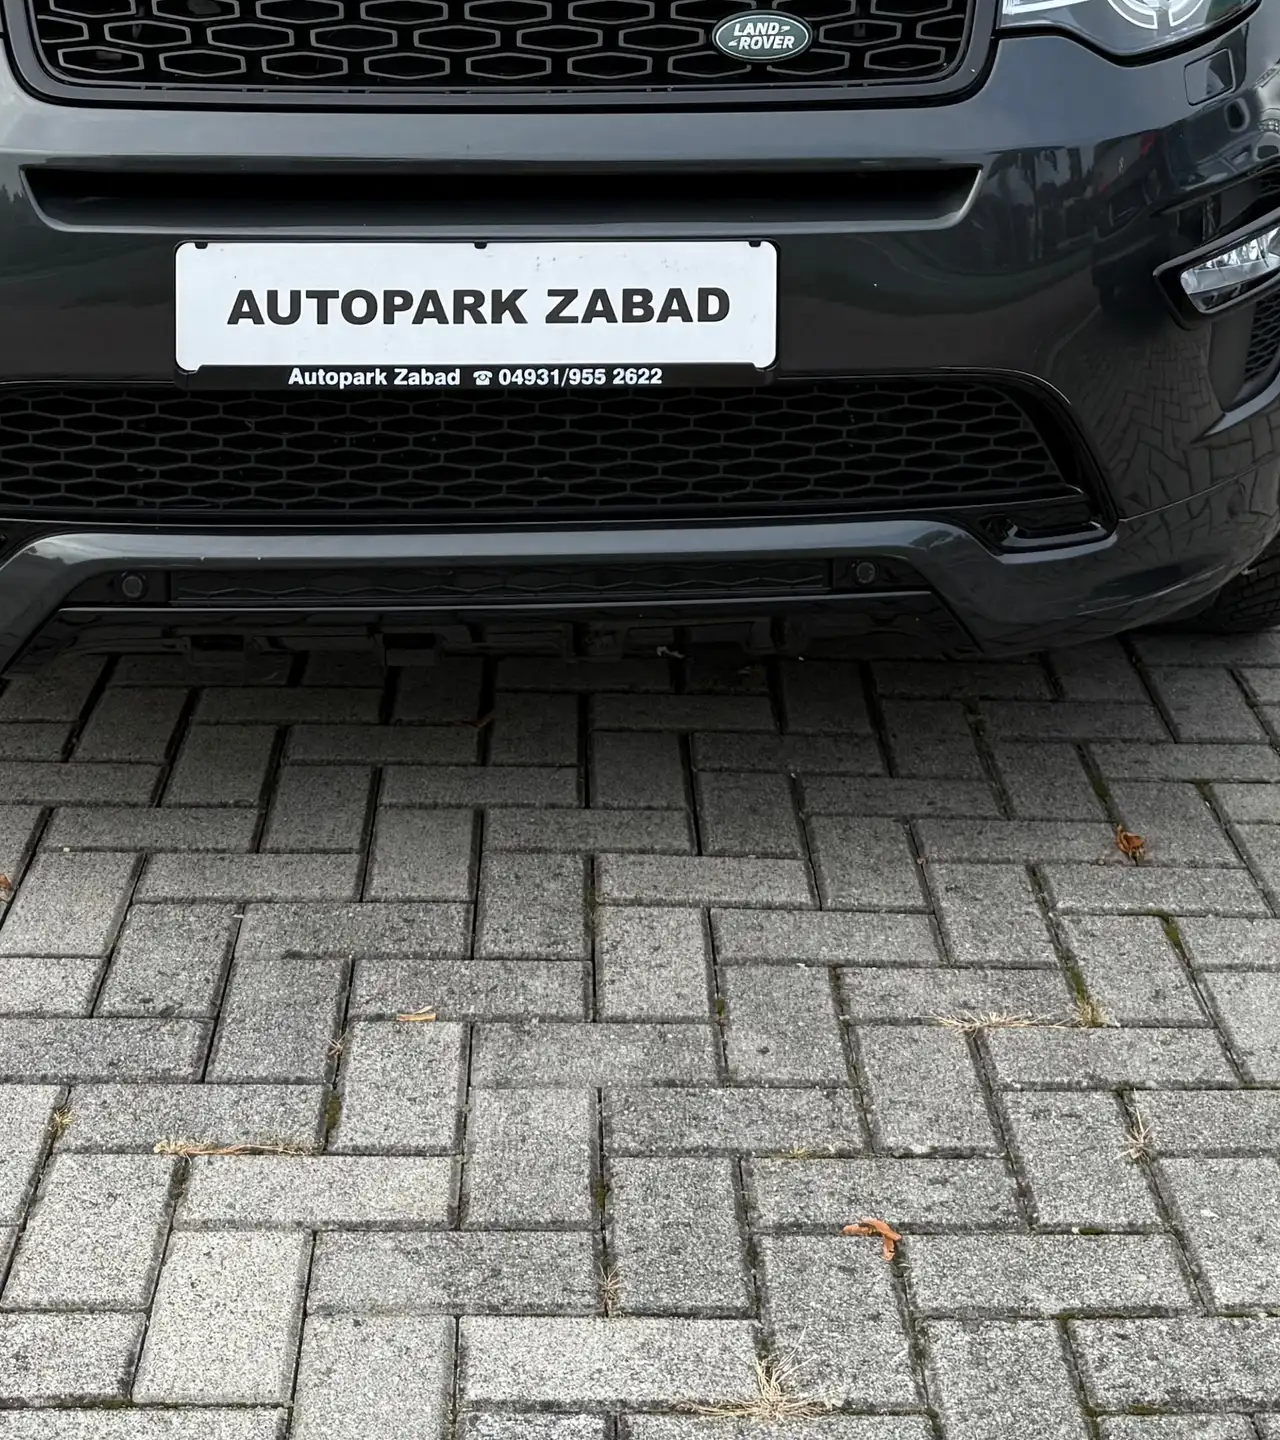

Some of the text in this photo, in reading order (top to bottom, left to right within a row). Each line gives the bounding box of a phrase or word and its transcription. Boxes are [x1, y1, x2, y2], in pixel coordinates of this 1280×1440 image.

[733, 22, 780, 36] LAND
[738, 35, 795, 50] ROVER
[227, 286, 731, 325] AUTOPARK ZABAD
[288, 366, 663, 389] Autopark Zabad 04931/955 2622
